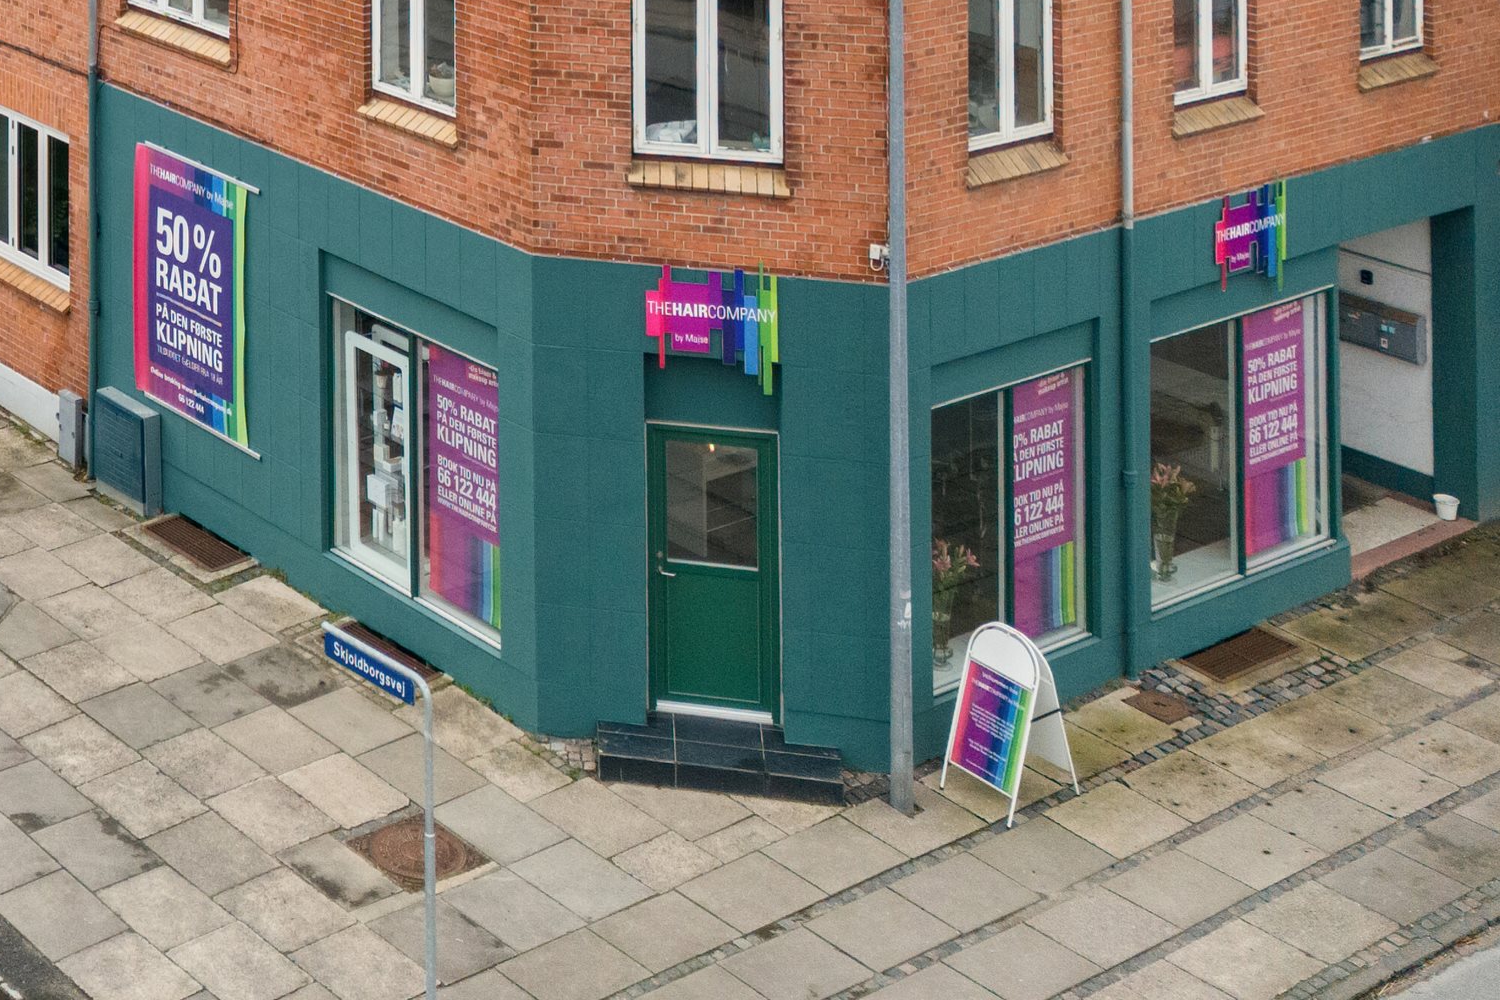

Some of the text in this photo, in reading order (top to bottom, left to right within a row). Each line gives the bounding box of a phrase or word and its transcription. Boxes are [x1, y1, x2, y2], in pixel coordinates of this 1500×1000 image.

[150, 162, 206, 197] THEHAIRCOMPANY
[1216, 213, 1284, 243] THEHAIRCOMPANY
[156, 257, 222, 315] RABAT
[156, 303, 222, 348] PÅ DEN FØRSTE
[648, 300, 776, 324] THEHAIRCOMPANY
[156, 320, 222, 373] KLIPNING
[675, 334, 684, 344] by
[1248, 344, 1297, 373] 50% RABAT
[1248, 361, 1297, 387] PÅ DEN FØRSTE
[1248, 373, 1297, 405] KLIPNING
[437, 393, 496, 435] 50% RABAT
[437, 411, 496, 449] PÅ DEN FØRSTE
[1249, 400, 1297, 429] BOOK TID NU PÅ
[1249, 413, 1297, 445] 66 122 444
[437, 423, 496, 468] KLIPNING
[1013, 419, 1063, 449] 0% RABAT
[1020, 446, 1035, 461] DEN
[1036, 437, 1064, 456] FØRSTE
[1249, 430, 1298, 458] ELLER ONLINE PÅ
[437, 454, 458, 473] BOOK
[460, 465, 471, 480] TID
[473, 472, 484, 487] NU
[486, 478, 496, 494] PÅ
[1014, 450, 1064, 482] LIPNING
[437, 466, 496, 511] 66 122 444
[437, 484, 496, 525] ELLER ONLINE PÅ
[1014, 479, 1064, 508] OOK TID NU PÅ
[1014, 494, 1064, 526] 6 122 444
[1014, 512, 1064, 539] LER ONLINE PÅ
[333, 641, 406, 698] Skjoldborgsvej
